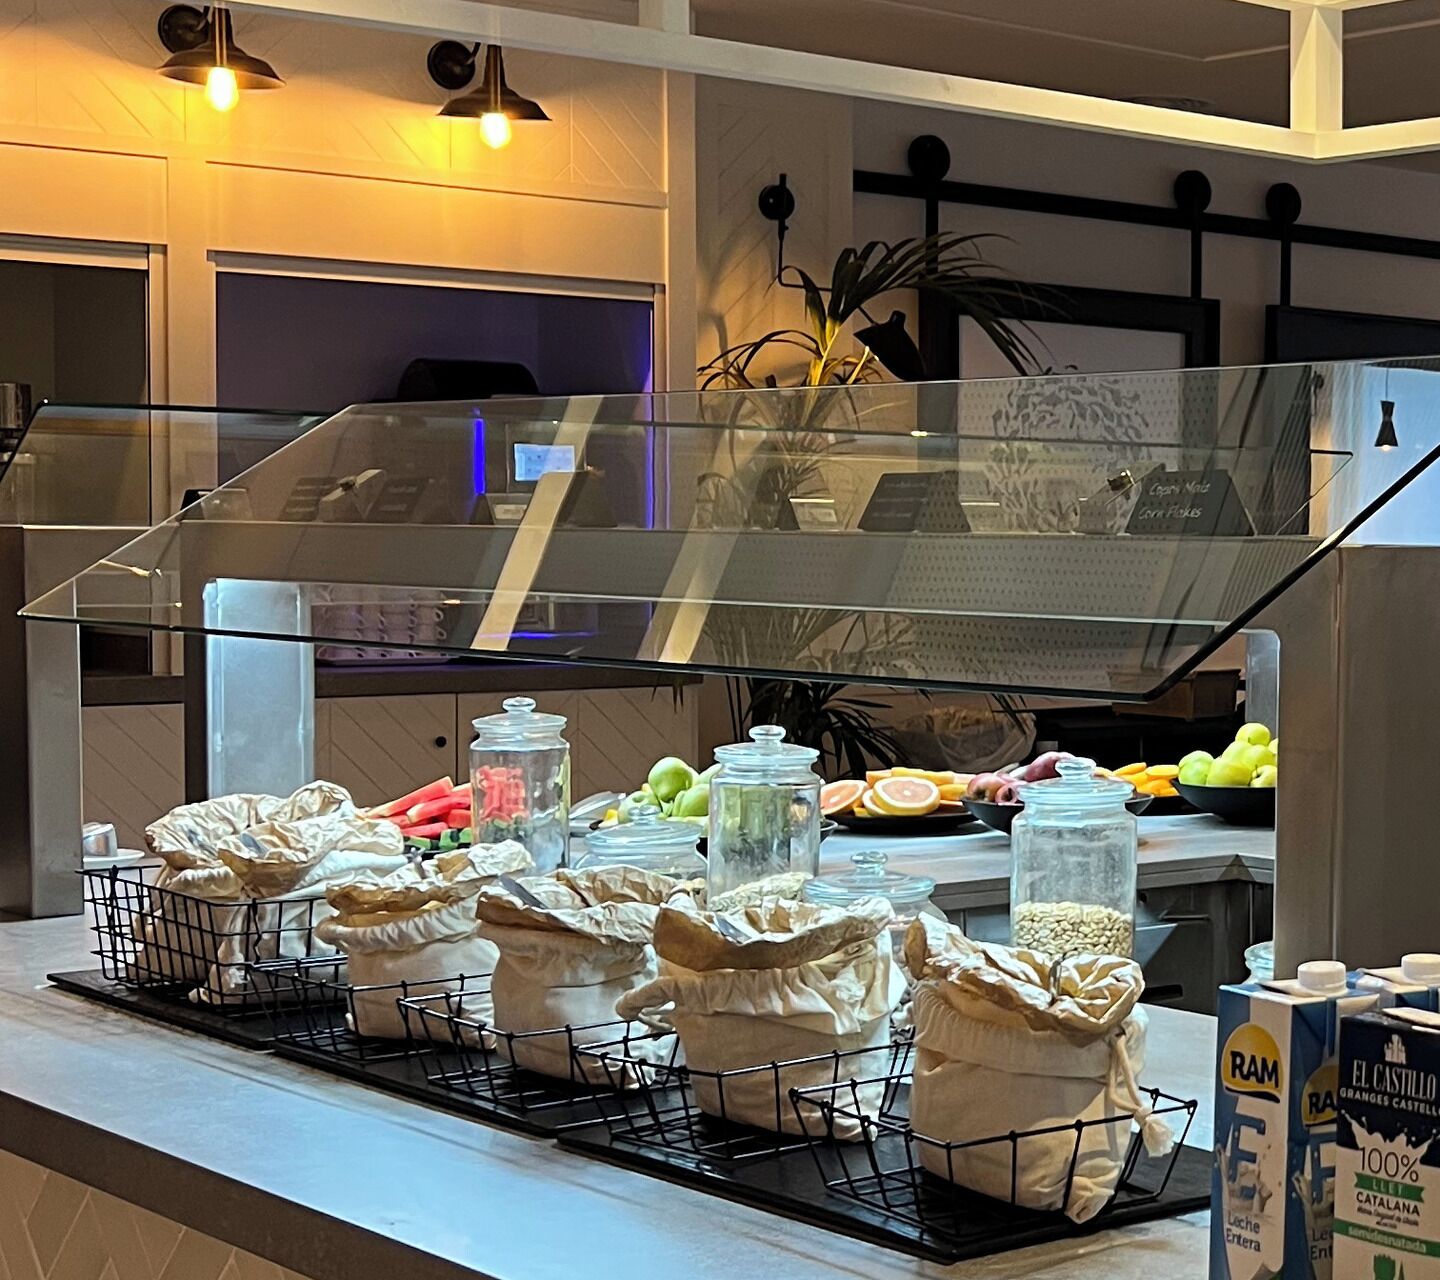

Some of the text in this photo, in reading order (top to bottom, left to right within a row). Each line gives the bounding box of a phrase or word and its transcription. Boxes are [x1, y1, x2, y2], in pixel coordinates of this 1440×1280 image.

[1230, 1050, 1279, 1089] RAM
[1353, 1059, 1437, 1101] EL CASTILLO
[1308, 1090, 1338, 1116] RA
[1340, 1087, 1389, 1106] GRANGES
[1360, 1146, 1419, 1183] 100%
[1372, 1178, 1404, 1197] LLET
[1356, 1191, 1421, 1217] CATALANA
[1227, 1209, 1261, 1234] Leche
[1226, 1228, 1262, 1253] Entera
